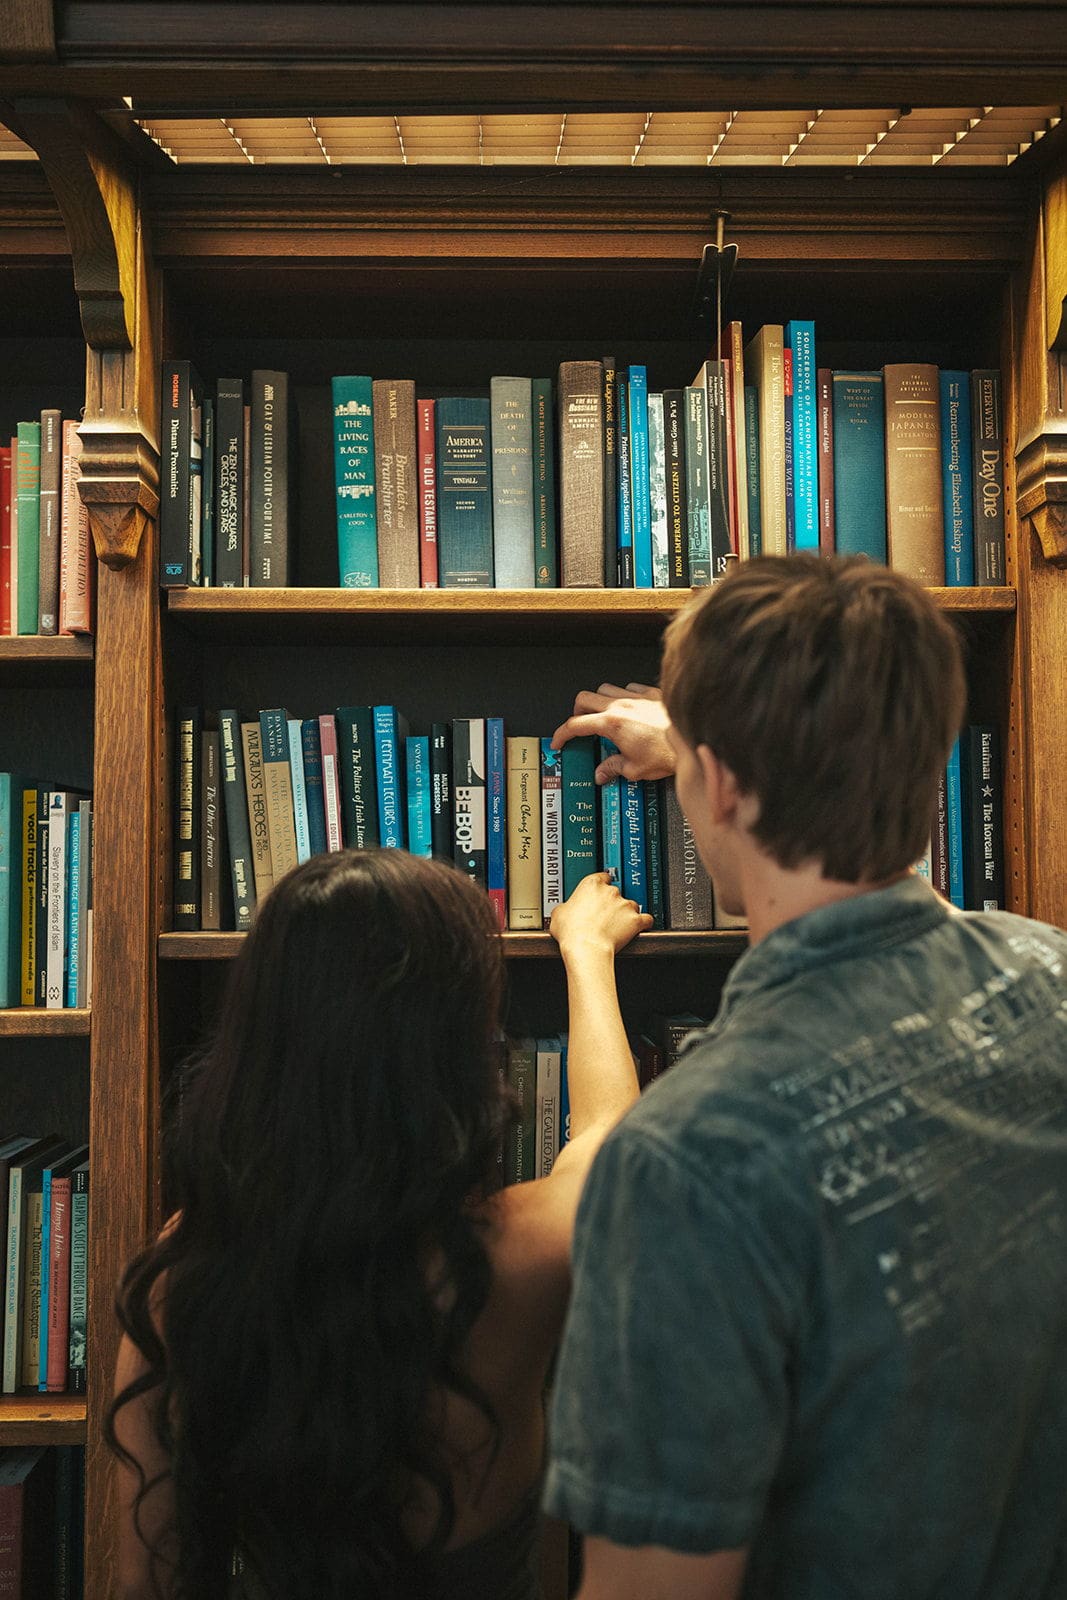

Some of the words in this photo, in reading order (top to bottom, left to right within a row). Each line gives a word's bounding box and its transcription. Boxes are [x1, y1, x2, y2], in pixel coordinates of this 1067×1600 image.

[772, 356, 782, 372] The
[773, 374, 783, 401] Visual
[804, 394, 810, 406] OF
[984, 379, 993, 406] PETER
[388, 390, 398, 420] BAKER
[344, 420, 362, 428] THE
[771, 403, 783, 437] Display
[785, 420, 792, 433] ON
[984, 407, 994, 439] WYDEN
[170, 419, 180, 450] Distant
[229, 438, 237, 452] THE
[338, 433, 370, 441] LIVING
[774, 438, 783, 449] of
[948, 401, 960, 471] Remembering
[229, 454, 237, 470] ZEN
[340, 446, 370, 454] RACES
[348, 458, 362, 467] OF
[424, 454, 433, 464] The
[621, 436, 629, 468] Principles
[170, 451, 178, 498] Proximities
[220, 455, 228, 488] CIRCLES,
[229, 471, 237, 482] OF
[424, 468, 434, 486] OLD
[622, 469, 629, 477] of
[979, 450, 1000, 481] Day
[380, 454, 394, 528] Frankfurter
[396, 453, 409, 511] Brandeis
[622, 478, 630, 502] Applied
[952, 472, 962, 516] Elizabeth
[229, 484, 237, 510] MAGIC
[674, 504, 680, 516] TO
[983, 483, 1001, 518] One
[424, 489, 436, 543] TESTAMENT
[227, 512, 237, 551] SQUARES,
[951, 519, 963, 553] Bishop
[78, 530, 88, 598] REVOLUTION
[222, 718, 233, 750] Encounter
[267, 716, 276, 757] LANDES
[275, 716, 284, 745] DAVID
[225, 750, 235, 766] with
[247, 730, 262, 790] MALRAUX'S
[277, 748, 285, 757] S.
[352, 748, 361, 763] The
[982, 733, 992, 780] Kaufman
[226, 766, 236, 782] Jung
[352, 766, 363, 793] Politics
[416, 777, 422, 787] OF
[492, 772, 500, 795] JAPAN
[520, 772, 529, 802] Sergeant
[207, 786, 216, 800] The
[271, 770, 281, 822] POVERTY
[280, 780, 288, 798] THE
[352, 794, 364, 803] of
[546, 793, 555, 808] The
[207, 804, 216, 829] Other
[253, 794, 268, 837] HEROES
[282, 804, 291, 847] WEALTH
[356, 805, 364, 823] Irish
[456, 789, 472, 854] BEBOP
[518, 804, 531, 834] Chung
[569, 814, 592, 823] Quest
[626, 800, 640, 834] Eighth
[984, 803, 993, 821] The
[28, 814, 36, 844] vocal
[274, 824, 282, 836] OF
[357, 826, 365, 848] Litera
[547, 811, 558, 845] WORST
[610, 810, 618, 844] Talking
[206, 830, 216, 868] America
[518, 836, 531, 860] Ming
[628, 837, 640, 868] Lively
[952, 834, 960, 858] Political
[984, 823, 994, 859] Korean
[28, 848, 36, 883] tracks
[51, 846, 62, 872] Slavery
[548, 848, 558, 876] HARD
[650, 840, 658, 877] Jonathan
[951, 858, 960, 884] Thought
[985, 860, 994, 881] War
[52, 873, 60, 881] on
[52, 882, 61, 894] the
[632, 869, 641, 886] Art
[548, 879, 559, 904] TIME
[52, 894, 61, 923] Frontiers
[686, 890, 694, 922] KNOPF
[52, 933, 60, 951] Islam
[544, 1099, 552, 1114] THE
[544, 1116, 552, 1156] GALILEO
[74, 1196, 86, 1228] SHAPING
[32, 1225, 42, 1240] The
[74, 1229, 86, 1258] SOCIETY
[30, 1241, 42, 1276] Meaning
[30, 1278, 41, 1288] of
[73, 1260, 85, 1295] THROUGH
[30, 1289, 42, 1339] Shakespeare
[73, 1296, 84, 1320] DANCE
